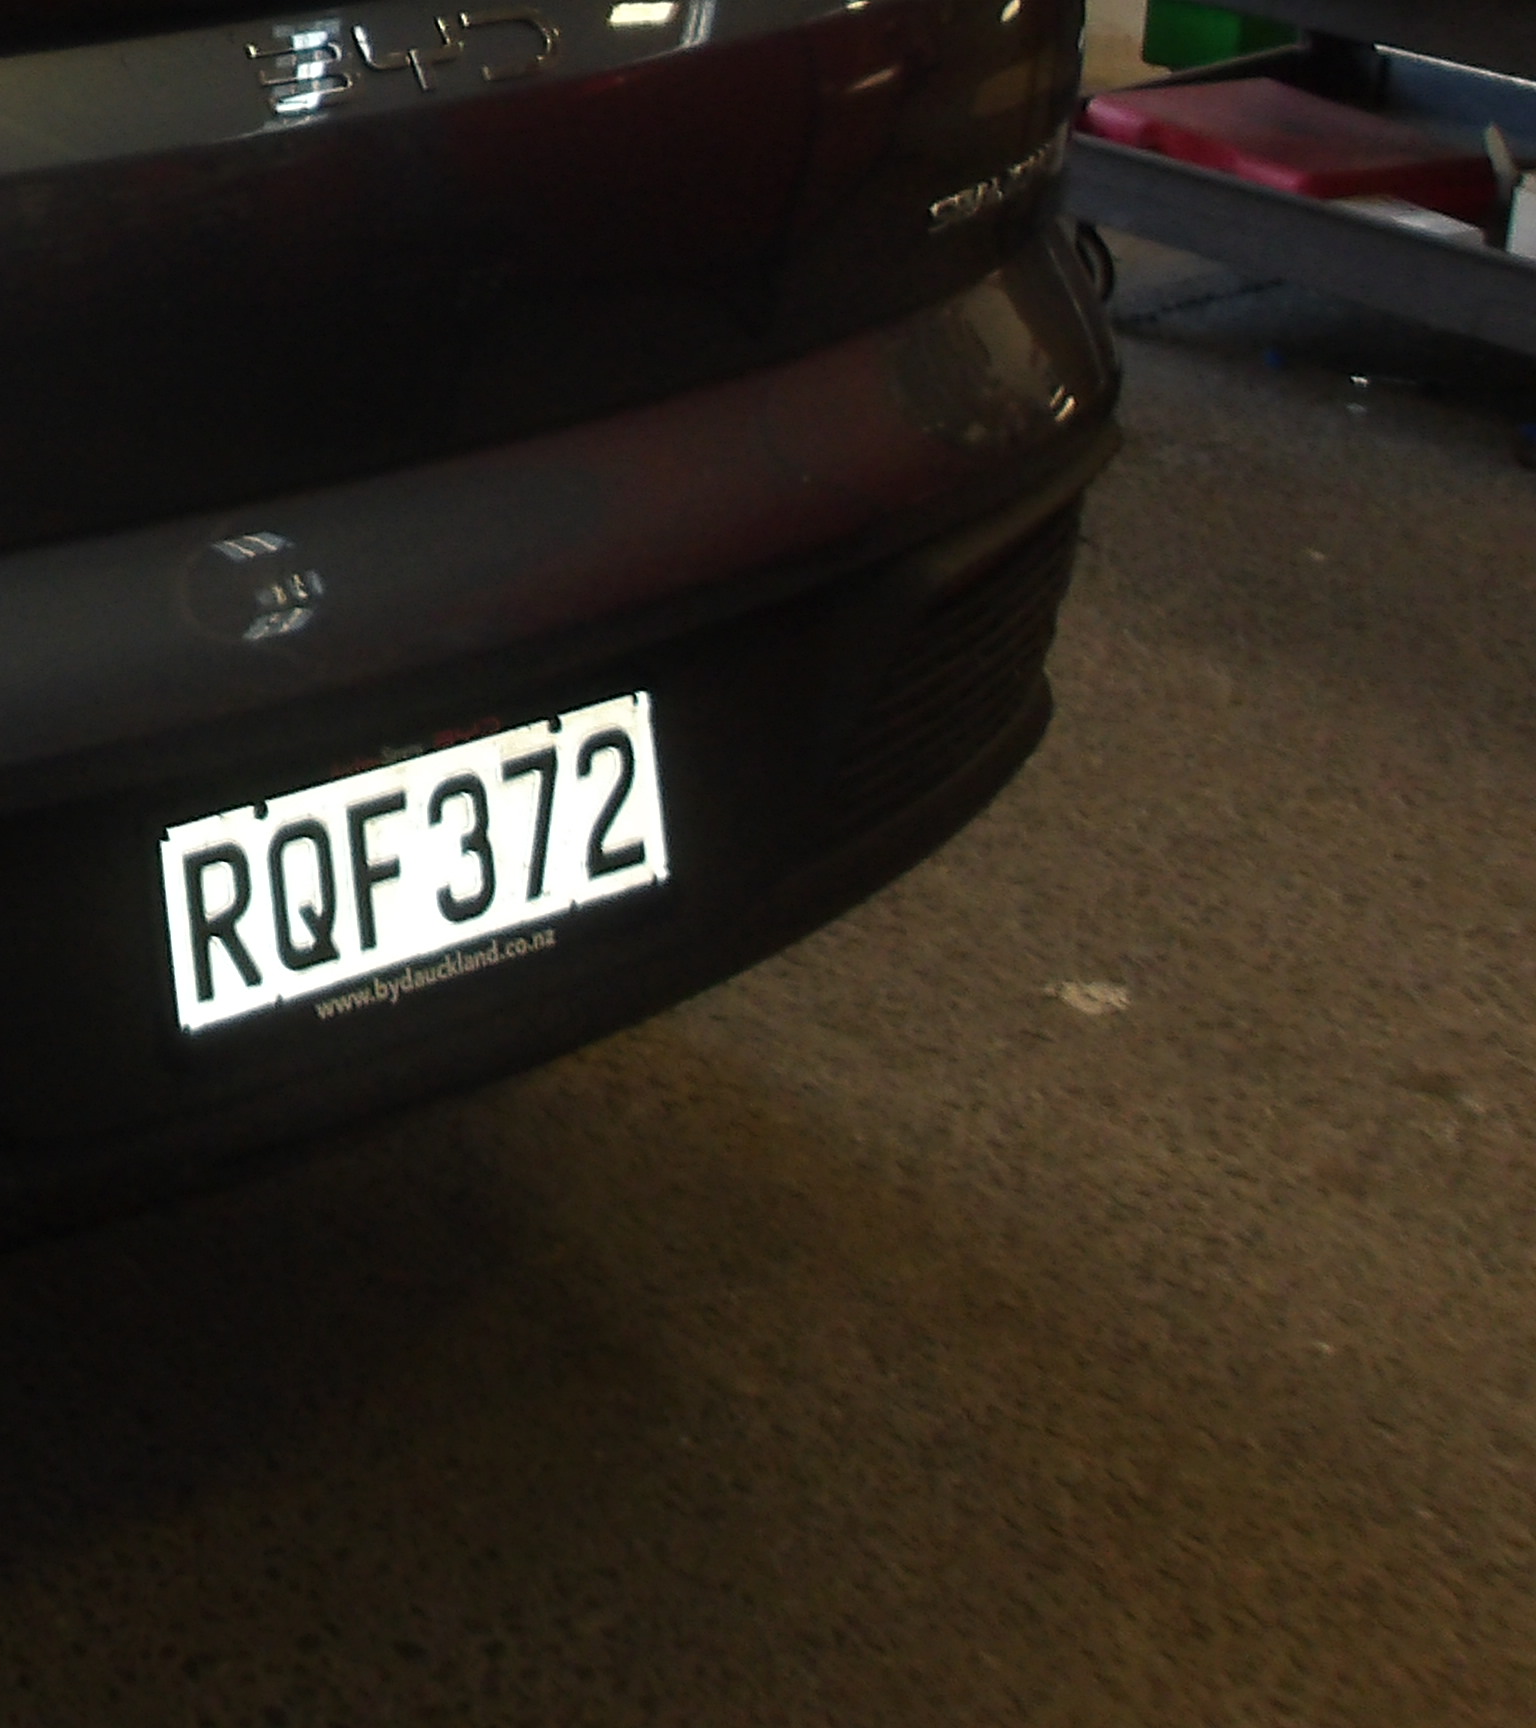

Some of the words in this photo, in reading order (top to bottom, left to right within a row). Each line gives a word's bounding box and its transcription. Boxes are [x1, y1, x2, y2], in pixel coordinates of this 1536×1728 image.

[244, 10, 561, 115] BYD
[183, 728, 646, 1003] RQF372
[315, 928, 557, 1020] www.bydauckland.co.nz
